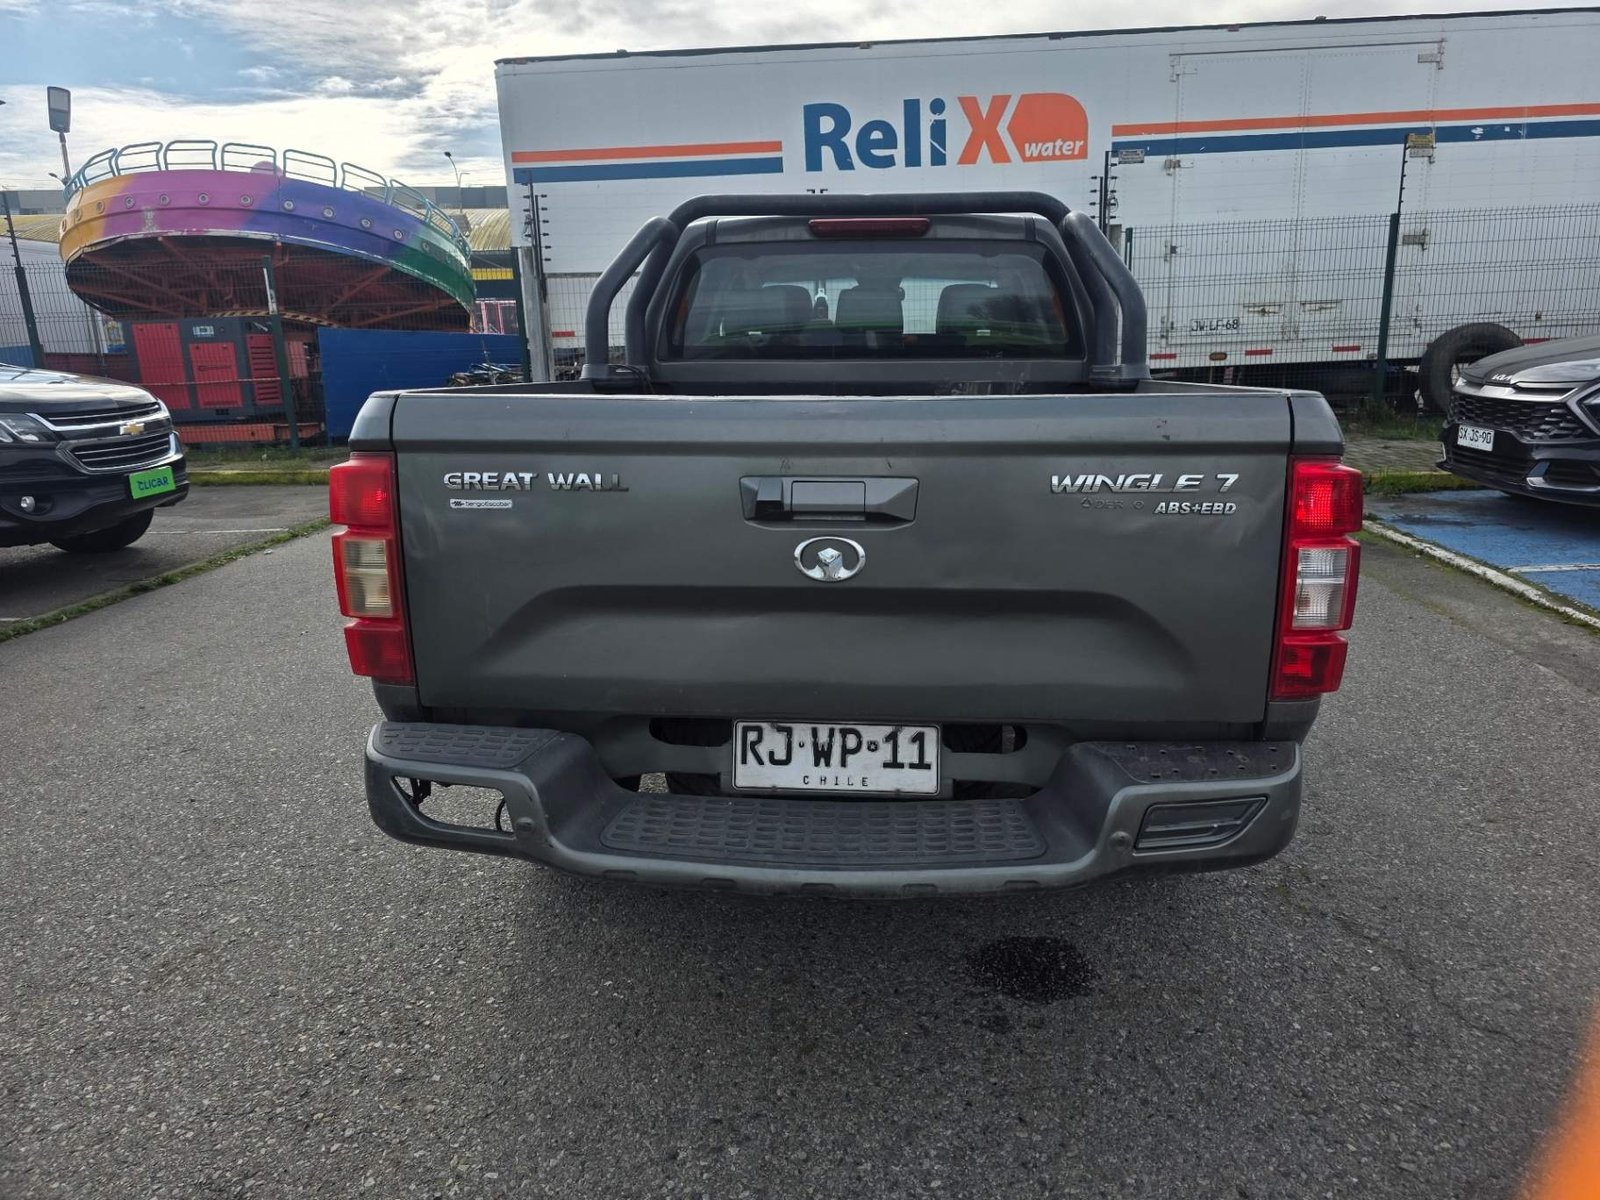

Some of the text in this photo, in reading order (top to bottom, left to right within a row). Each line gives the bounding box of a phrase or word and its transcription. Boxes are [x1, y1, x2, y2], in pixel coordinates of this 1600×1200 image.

[1024, 138, 1084, 158] water
[443, 472, 629, 492] GREAT WALL
[1051, 473, 1239, 493] WINGLE 7
[1154, 502, 1237, 515] ABS+EBD
[803, 775, 868, 787] CHILE
